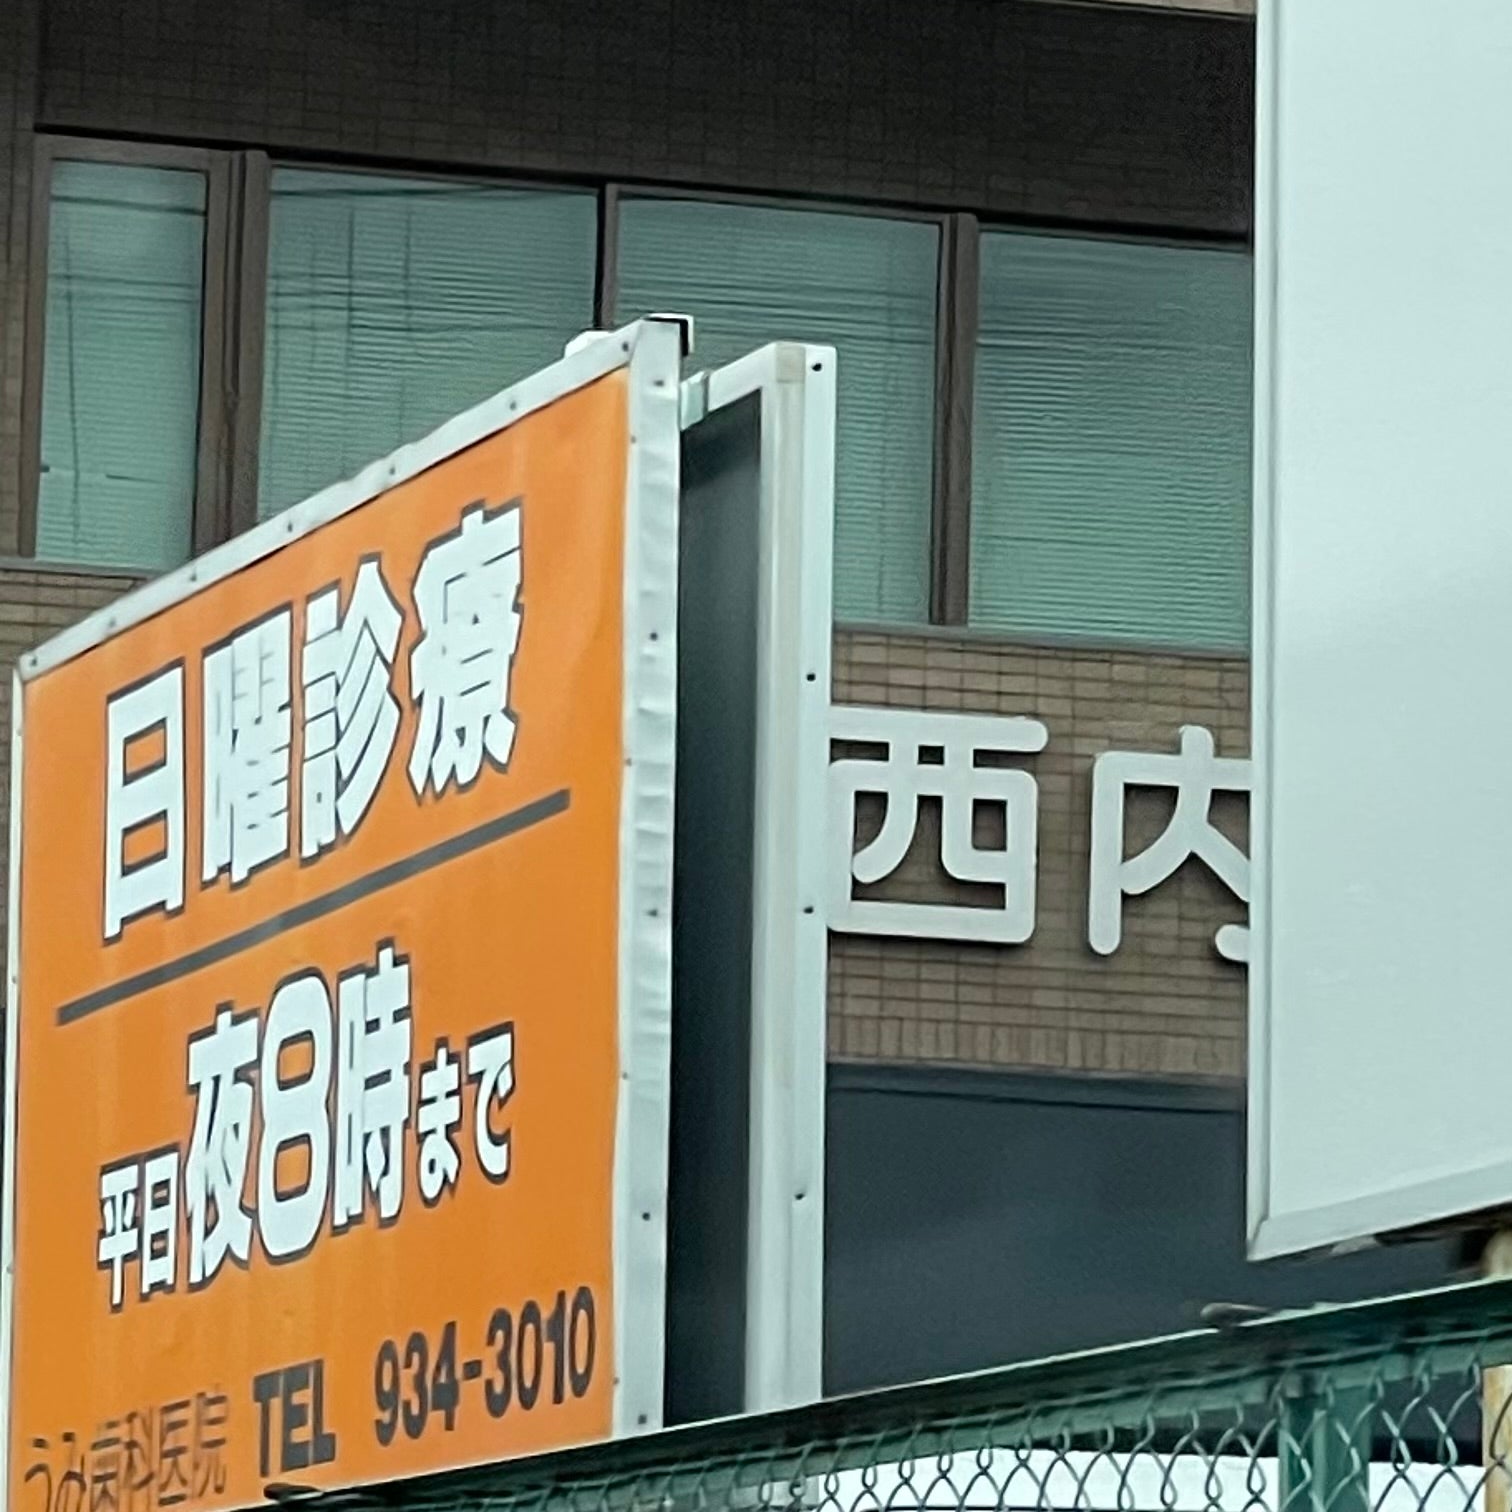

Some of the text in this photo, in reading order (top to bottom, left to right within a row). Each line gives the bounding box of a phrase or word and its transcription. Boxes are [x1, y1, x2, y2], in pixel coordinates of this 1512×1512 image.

[103, 496, 524, 946] 日曜診療
[252, 1358, 337, 1478] TEL
[373, 1285, 597, 1448] 934-3010
